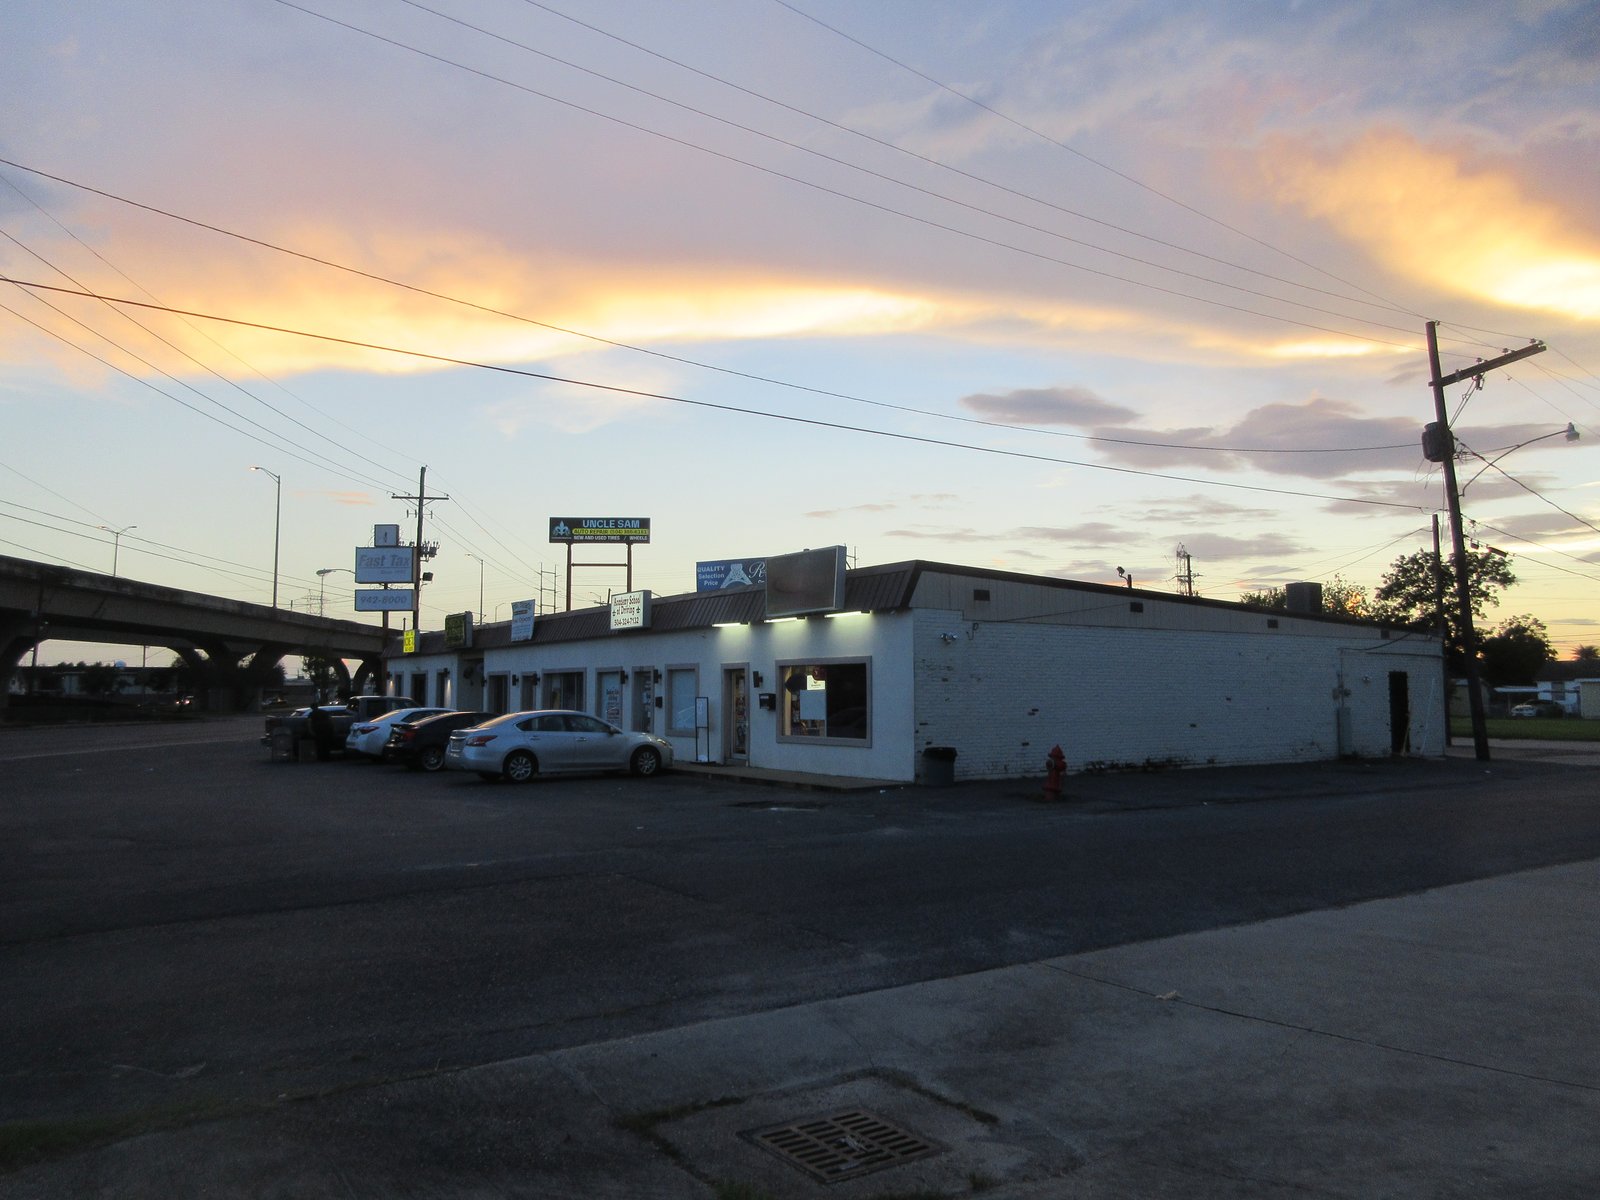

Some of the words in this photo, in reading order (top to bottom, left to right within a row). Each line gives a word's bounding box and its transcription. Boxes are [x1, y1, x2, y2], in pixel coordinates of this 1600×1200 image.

[582, 520, 615, 528] UNCLE
[618, 520, 640, 528] SAM
[360, 554, 385, 566] Fast
[390, 554, 410, 566] Tax
[614, 598, 628, 607] Academy
[629, 595, 640, 604] School
[616, 606, 620, 615] of
[621, 606, 635, 616] Driving
